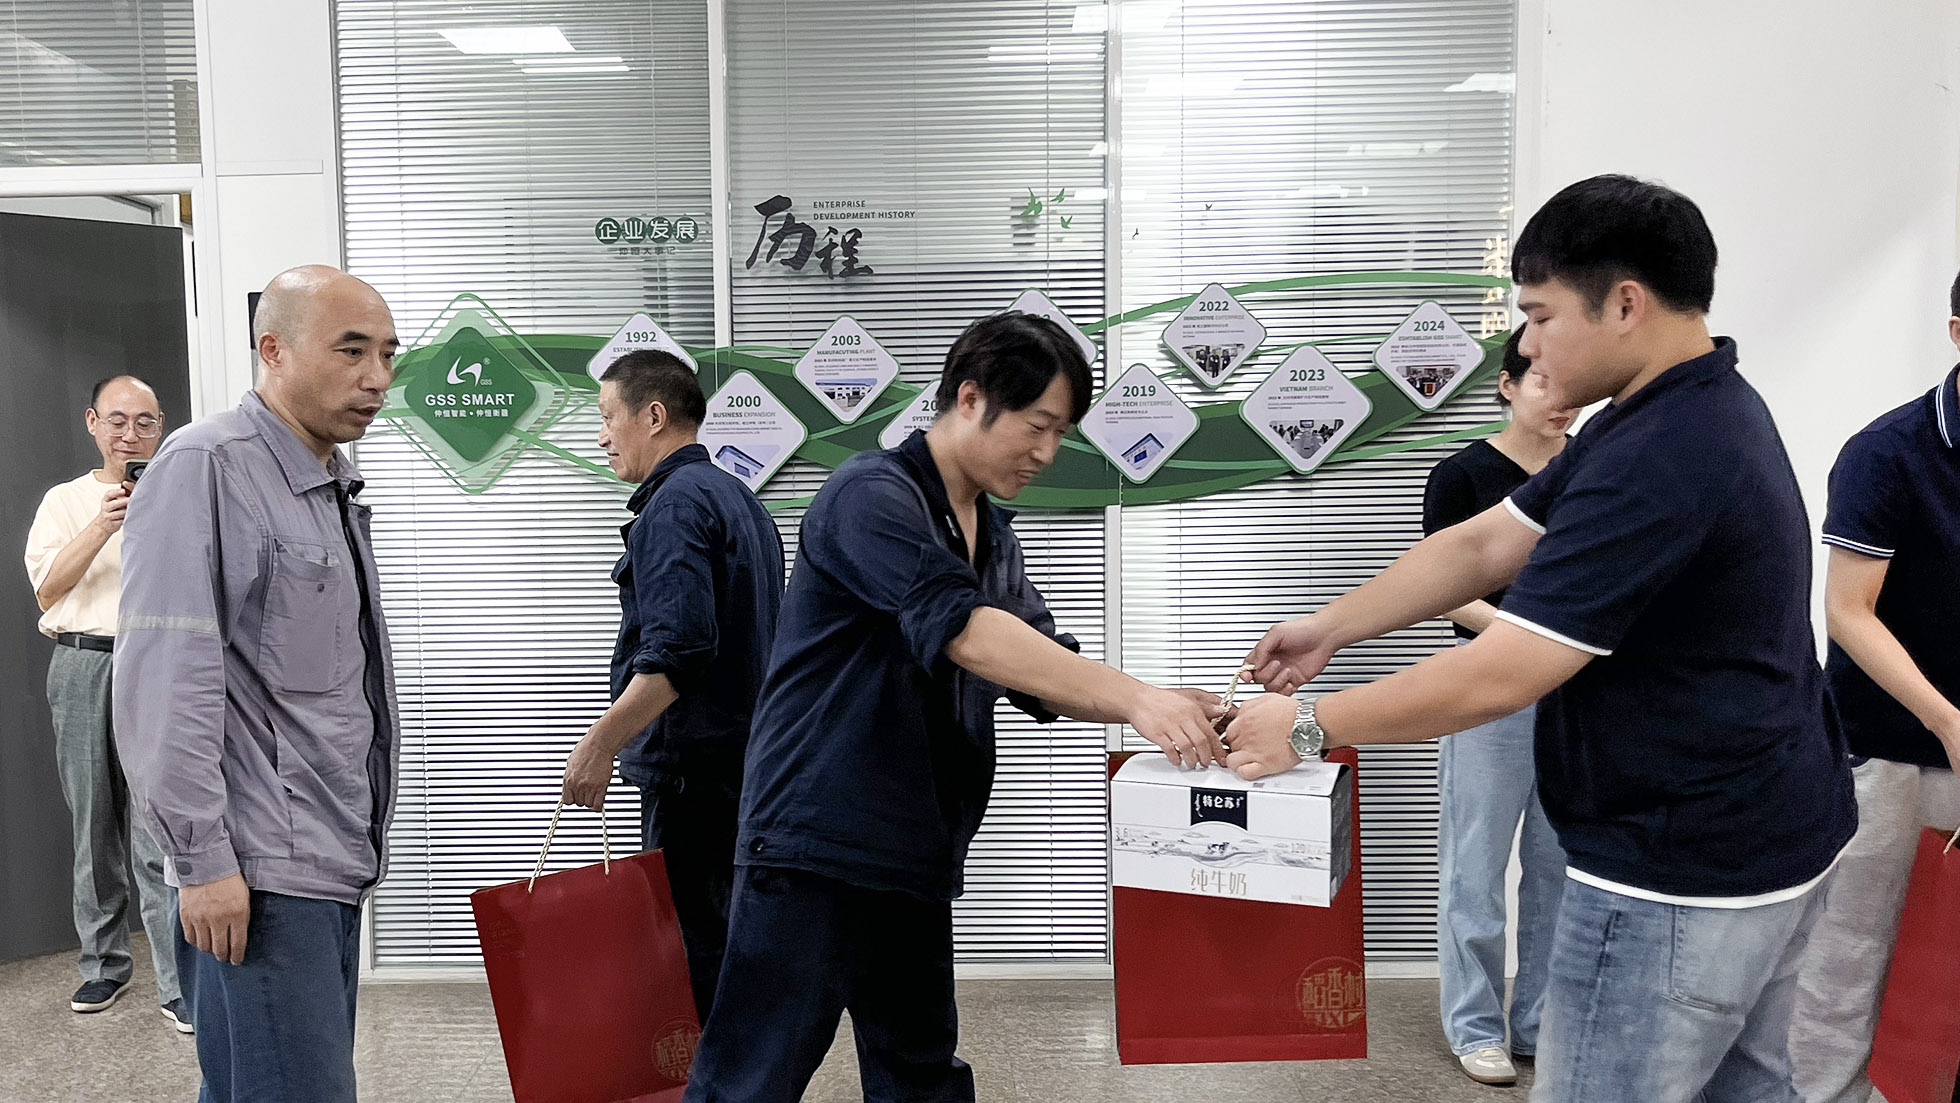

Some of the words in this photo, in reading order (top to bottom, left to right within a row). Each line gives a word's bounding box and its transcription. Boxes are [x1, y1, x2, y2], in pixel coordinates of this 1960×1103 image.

[813, 200, 866, 209] ENTERPRISE
[813, 212, 875, 221] DEVELOPMENT
[878, 211, 916, 219] HISTORY
[597, 218, 698, 242] 企业发展
[1199, 301, 1230, 312] 2022
[1414, 320, 1446, 331] 2024
[625, 331, 657, 343] 1992
[831, 335, 861, 346] 2003
[1289, 369, 1325, 382] 2023
[1122, 385, 1156, 397] 2019
[425, 394, 457, 406] GSS
[461, 394, 515, 406] SMART
[727, 395, 761, 408] 2000
[1190, 868, 1247, 895] 纯牛奶
